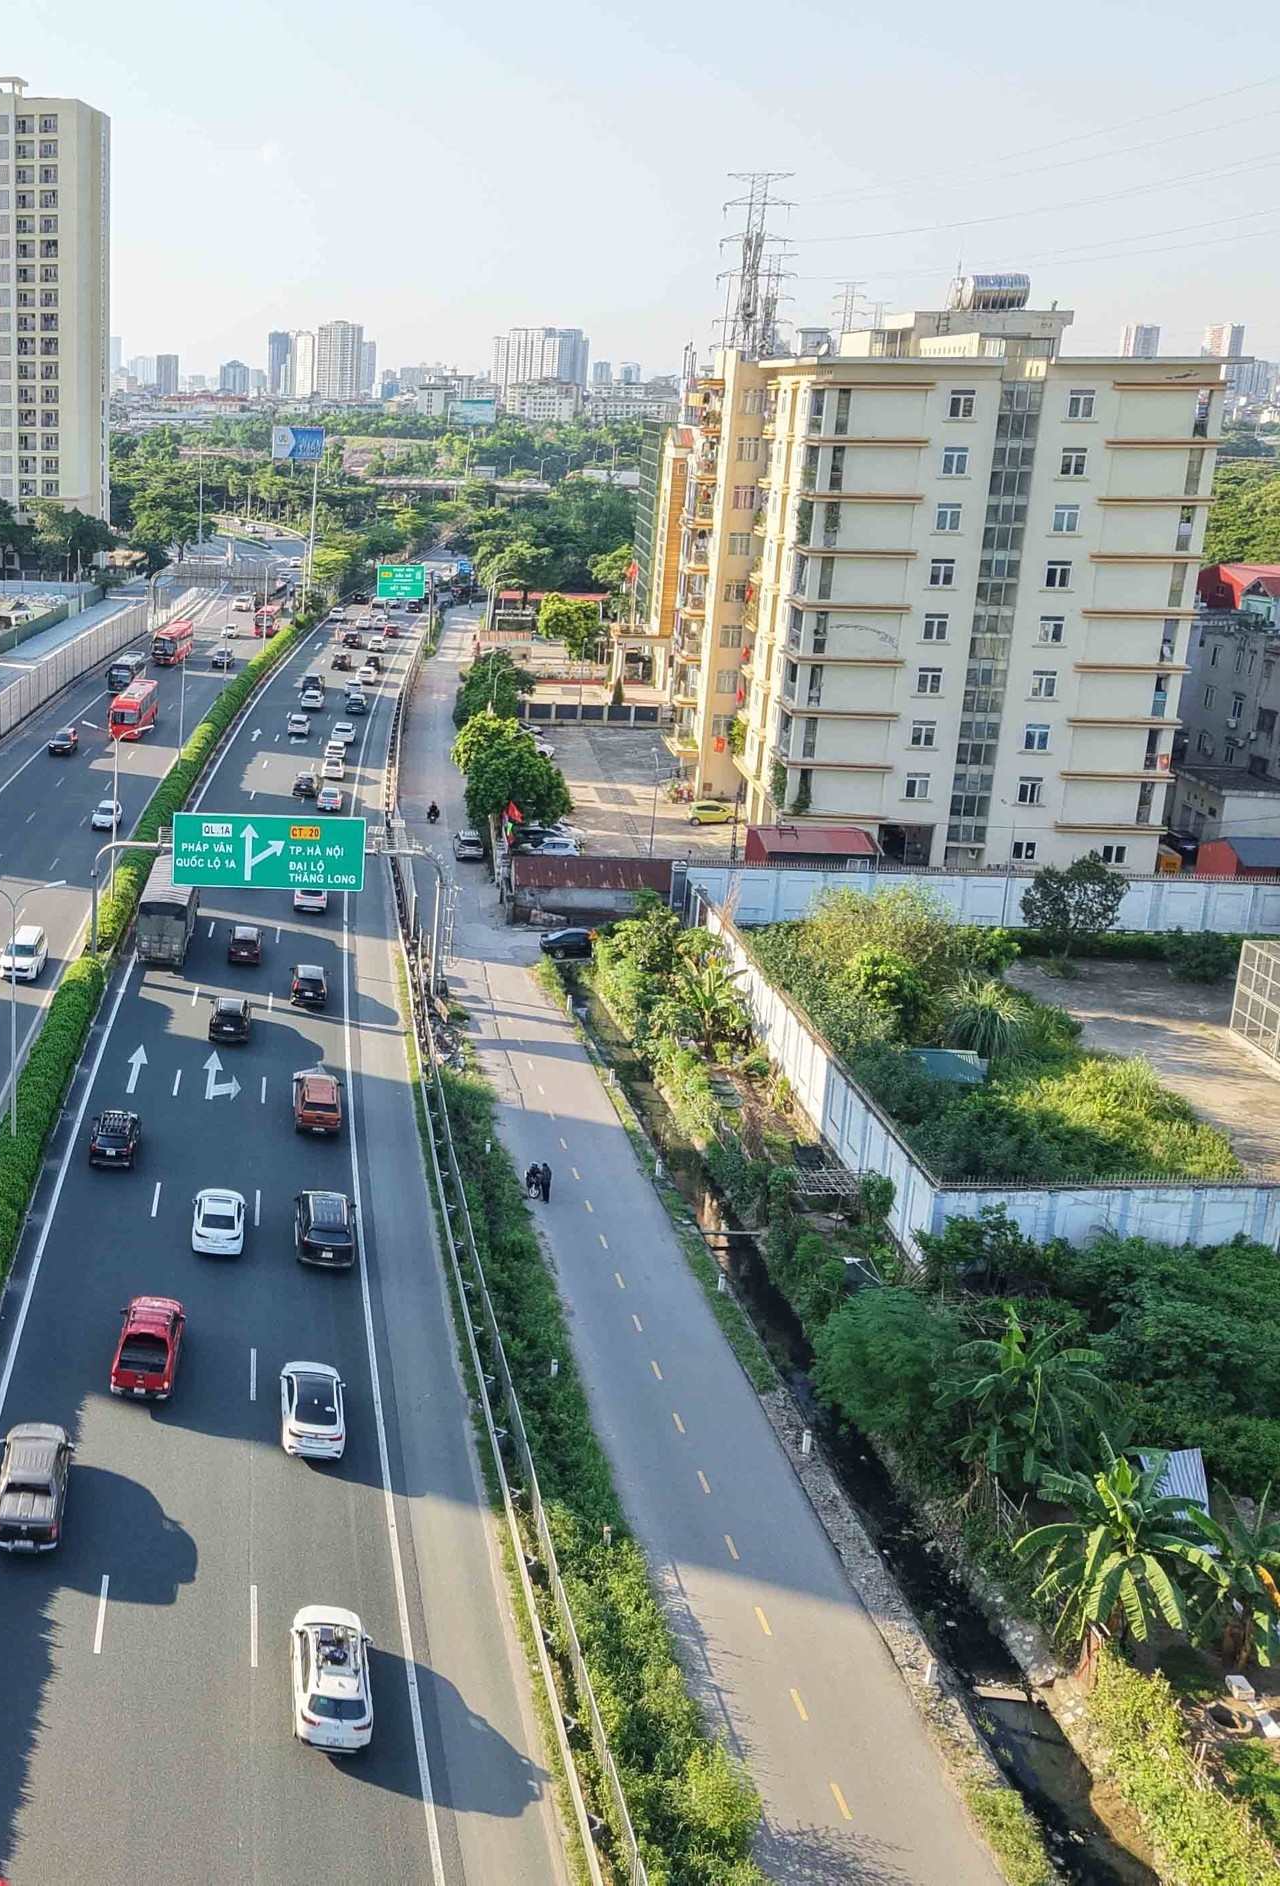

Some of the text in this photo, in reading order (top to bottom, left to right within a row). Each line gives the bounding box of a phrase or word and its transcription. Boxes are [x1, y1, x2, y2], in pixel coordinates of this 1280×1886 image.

[181, 841, 233, 853] PHÁP VÂN
[326, 845, 344, 859] NỘI
[175, 855, 236, 869] QUỐC LỘ 1A
[289, 860, 324, 873] ĐẠI LỘ
[289, 872, 356, 884] THĂNG LONG
